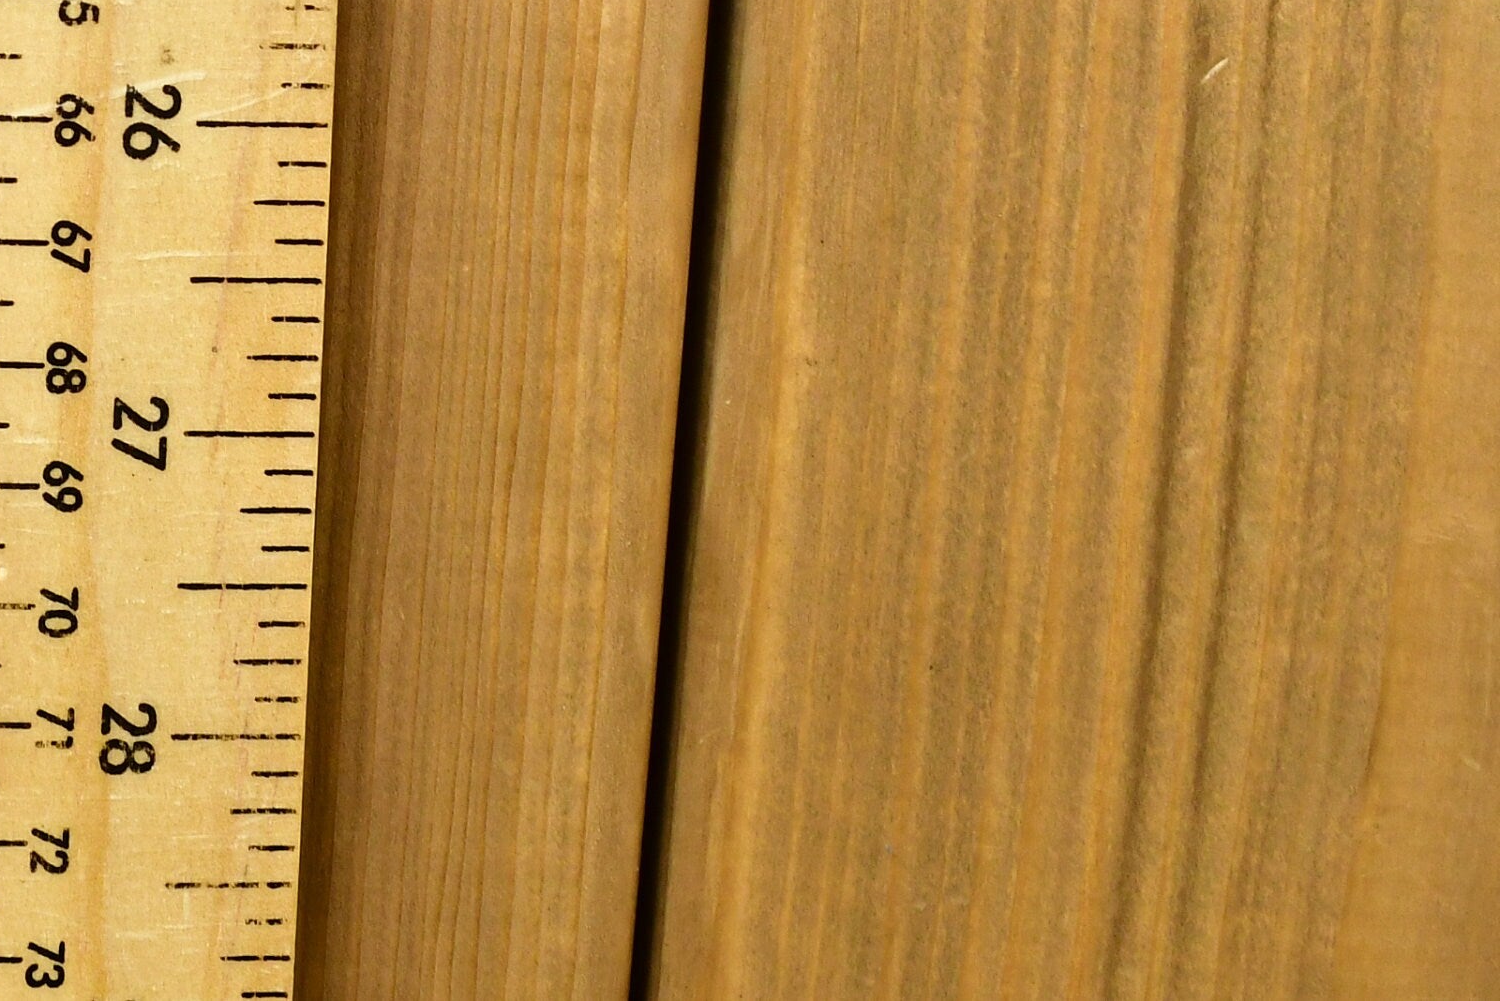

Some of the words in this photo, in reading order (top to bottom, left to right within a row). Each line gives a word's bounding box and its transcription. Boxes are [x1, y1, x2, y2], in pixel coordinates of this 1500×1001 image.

[55, 94, 94, 147] 66
[123, 85, 182, 160] 26
[51, 220, 92, 273] 67
[46, 342, 87, 394] 68
[111, 397, 169, 471] 27
[42, 461, 84, 512] 69
[38, 586, 79, 638] 70
[99, 703, 157, 775] 28
[30, 827, 69, 874] 72
[25, 941, 66, 988] 73
